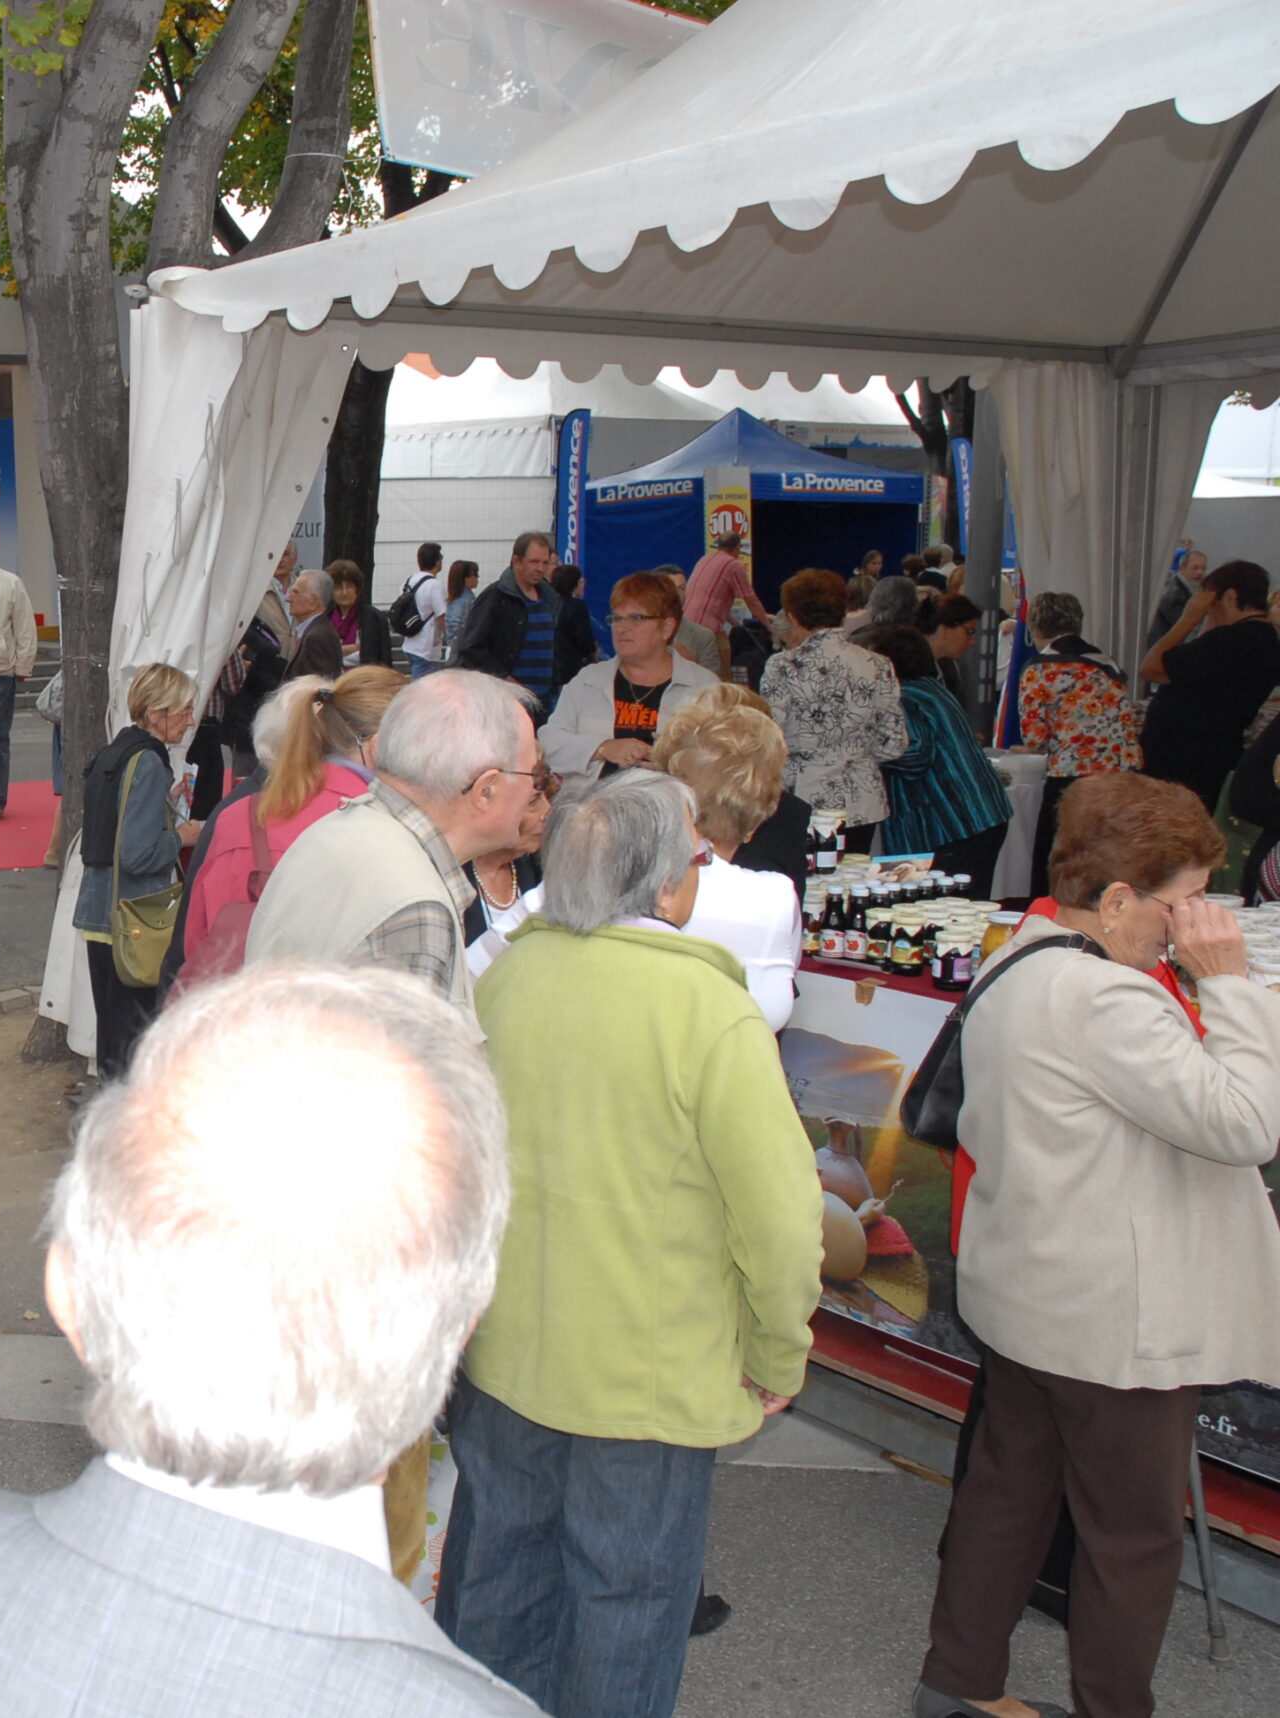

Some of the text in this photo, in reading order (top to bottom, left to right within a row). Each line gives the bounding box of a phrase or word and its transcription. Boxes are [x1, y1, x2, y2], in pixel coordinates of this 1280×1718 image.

[597, 479, 694, 503] La Provence
[782, 473, 884, 492] La Provence
[291, 522, 322, 539] zur
[1195, 1412, 1239, 1438] e.fr
